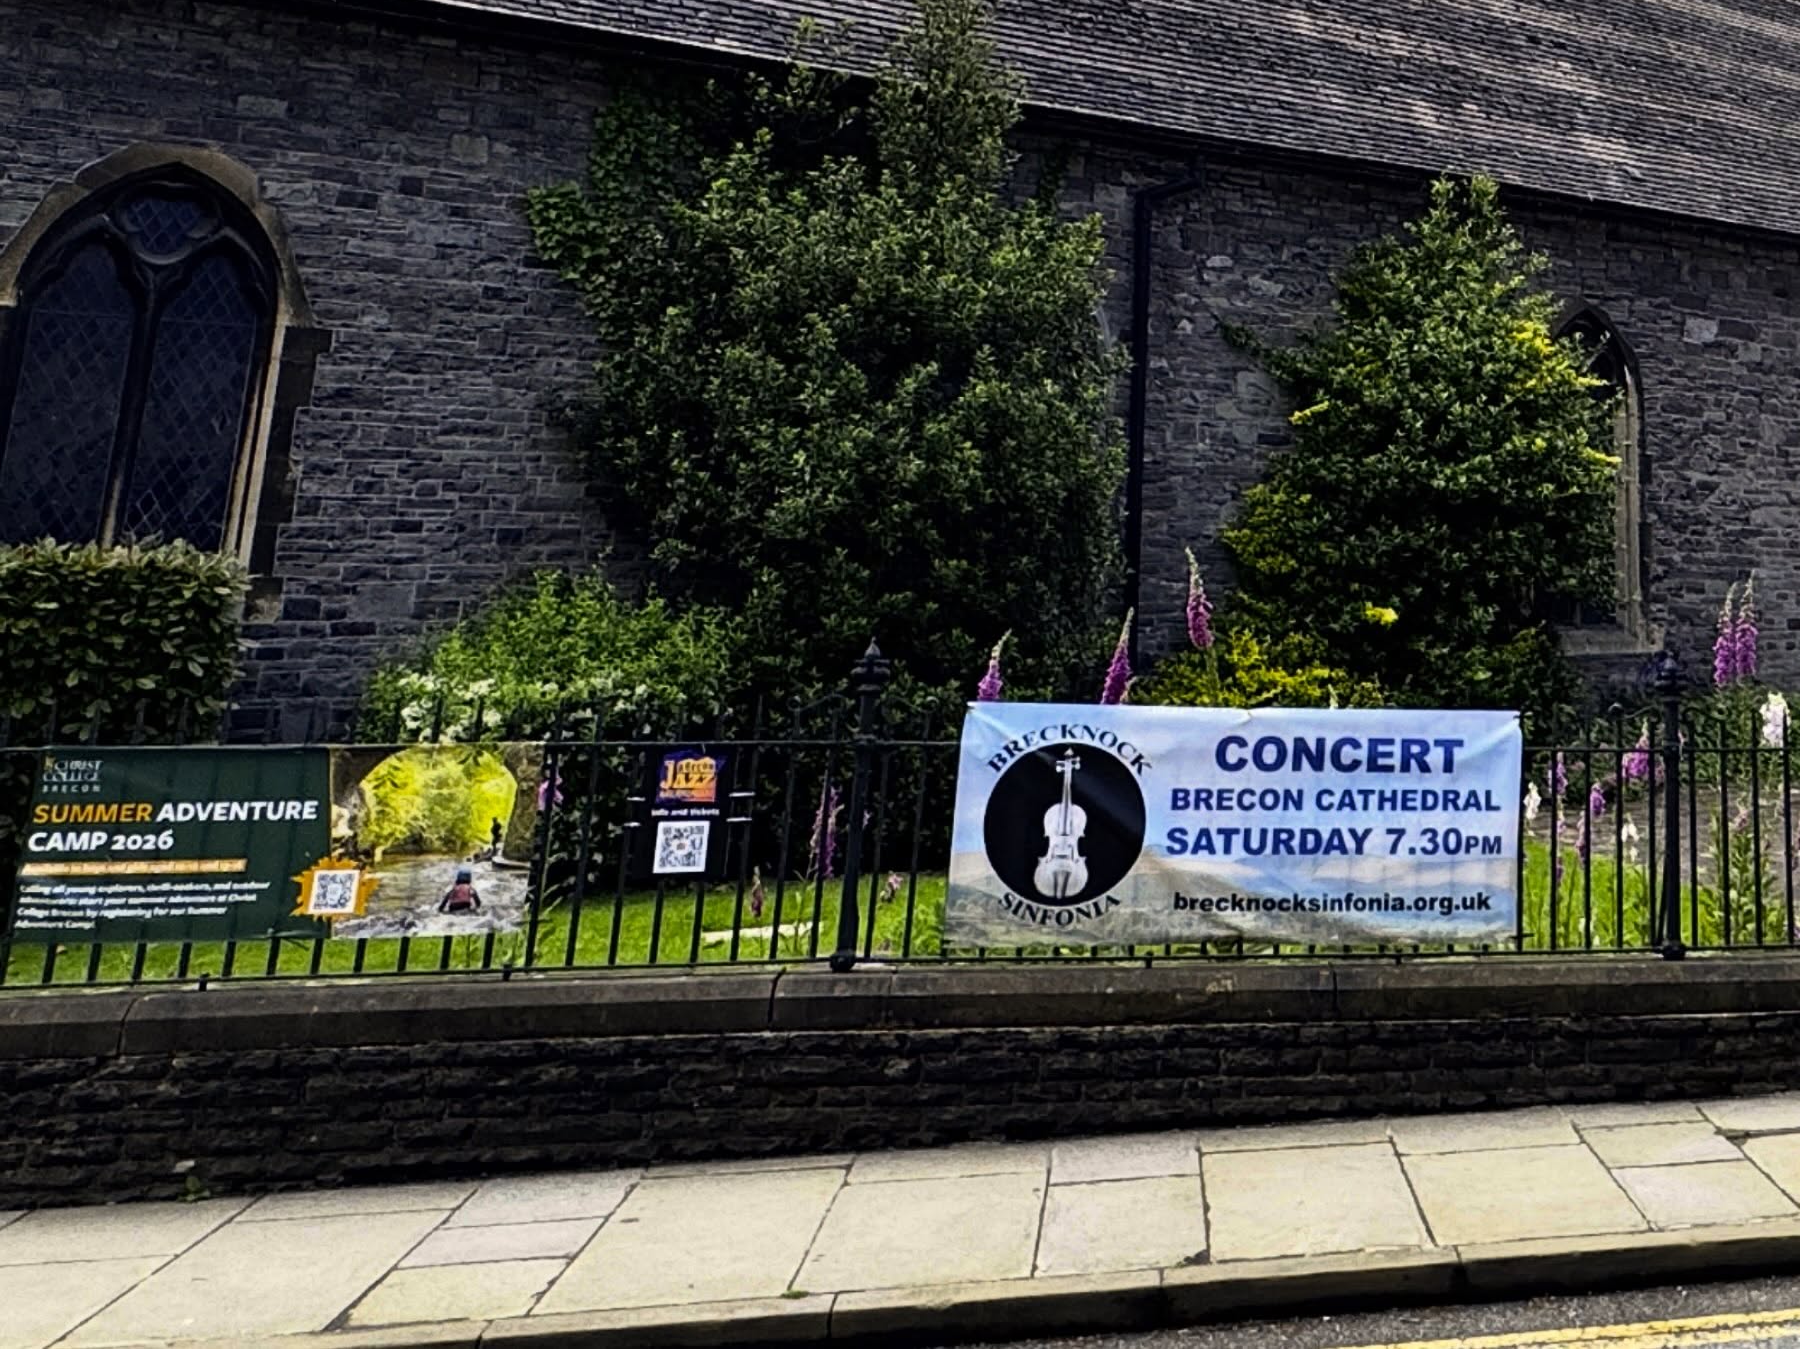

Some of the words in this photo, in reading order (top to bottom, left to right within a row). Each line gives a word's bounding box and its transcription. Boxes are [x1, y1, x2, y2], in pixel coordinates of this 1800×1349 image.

[986, 724, 1152, 776] BRECKNOCK
[1215, 735, 1464, 774] CONCERT
[33, 803, 153, 824] SUMMER
[156, 800, 319, 822] ADVENTURE
[1171, 788, 1303, 811] BRECON
[1315, 789, 1501, 811] CATHEDRAL
[28, 831, 108, 851] CAMP
[111, 829, 174, 850] 2026
[1166, 827, 1373, 855] SATURDAY
[1386, 827, 1502, 855] 7.30PM
[998, 891, 1121, 927] SINFONIA
[1173, 891, 1492, 916] brecknocksinfonia.org.uk
